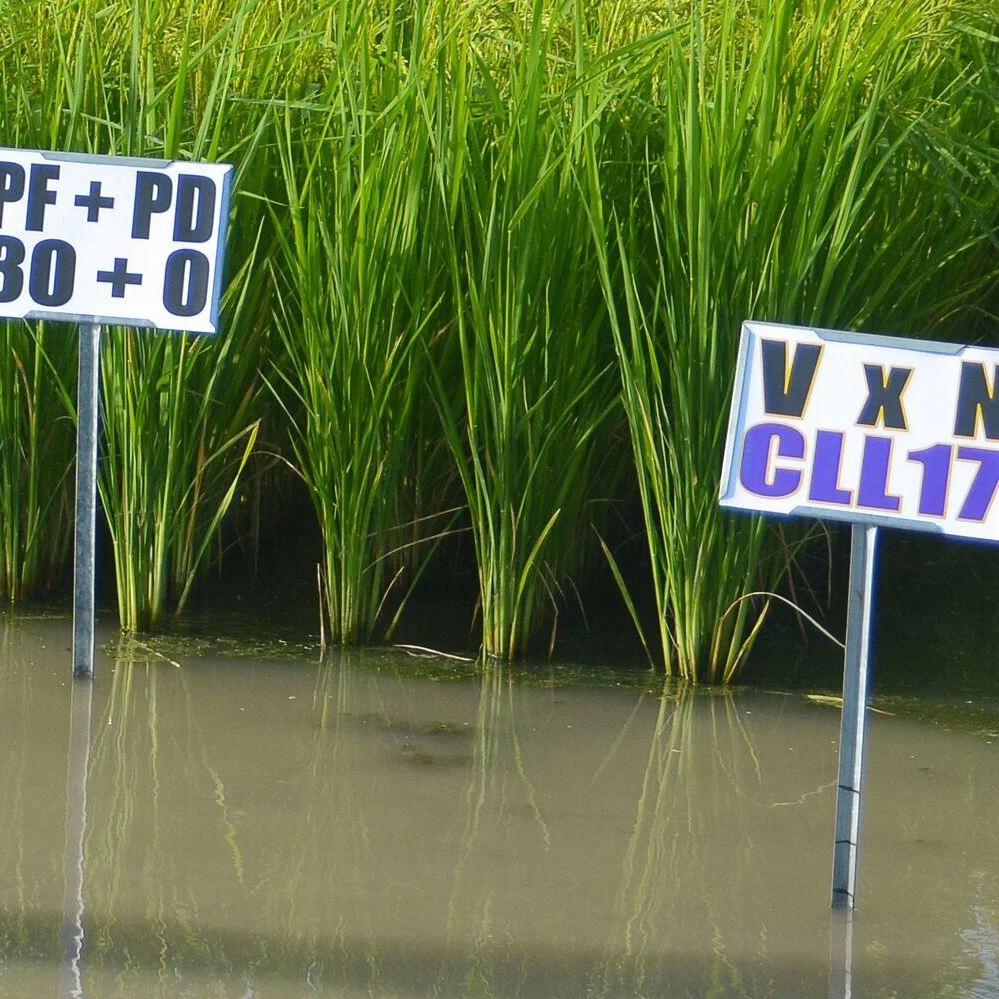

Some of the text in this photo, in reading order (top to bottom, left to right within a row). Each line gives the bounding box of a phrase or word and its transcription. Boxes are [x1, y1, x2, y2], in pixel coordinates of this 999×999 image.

[74, 180, 115, 223] +
[131, 171, 217, 244] PD
[96, 257, 143, 299] +
[162, 248, 210, 317] 0
[760, 337, 825, 419] V
[952, 359, 999, 443] N
[739, 421, 999, 523] CLL17
